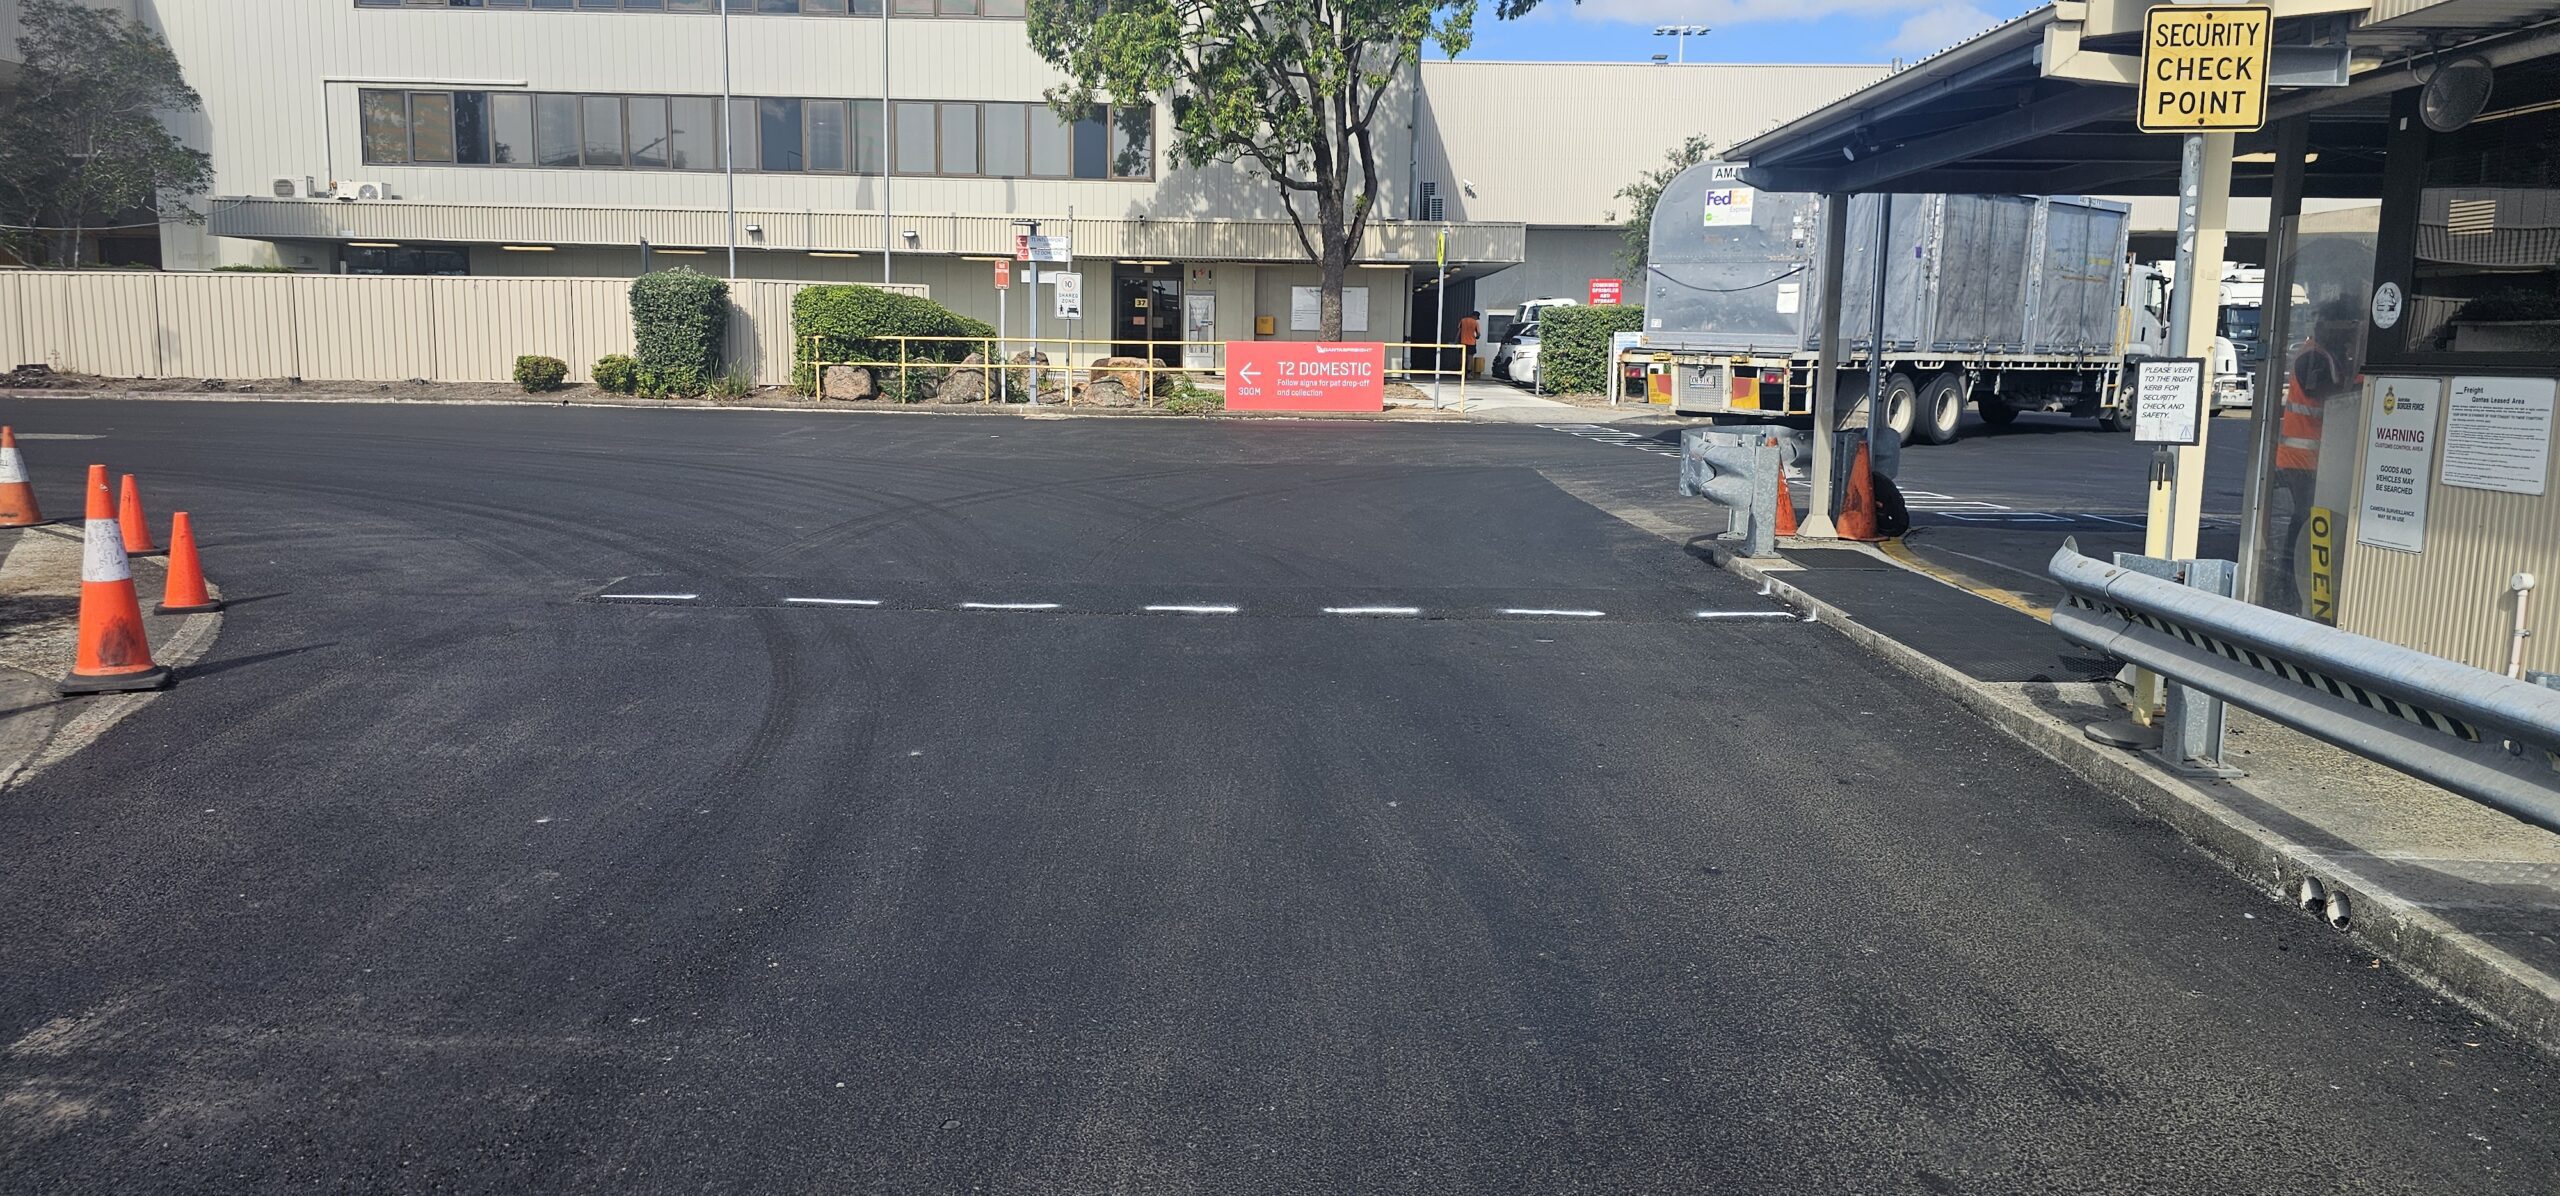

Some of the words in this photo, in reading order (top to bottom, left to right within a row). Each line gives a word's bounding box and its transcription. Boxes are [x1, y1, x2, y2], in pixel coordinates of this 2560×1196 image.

[2156, 22, 2260, 47] SECURITY
[2157, 56, 2253, 81] CHECK
[2158, 91, 2246, 114] POINT
[1706, 190, 1748, 206] FedEx
[1277, 362, 1295, 375] T2
[1300, 362, 1372, 376] DOMESTIC
[1300, 379, 1317, 388] signs
[1342, 379, 1370, 388] drop-off
[1238, 387, 1261, 396] 300M
[2464, 387, 2484, 395] Freight
[2377, 427, 2424, 442] WARNING
[2381, 465, 2399, 474] GOODS
[2376, 474, 2401, 483] VEHICLES
[2384, 485, 2413, 495] SEARCHED
[2386, 508, 2414, 517] SURVEILLANCE
[2312, 516, 2330, 622] OPEN
